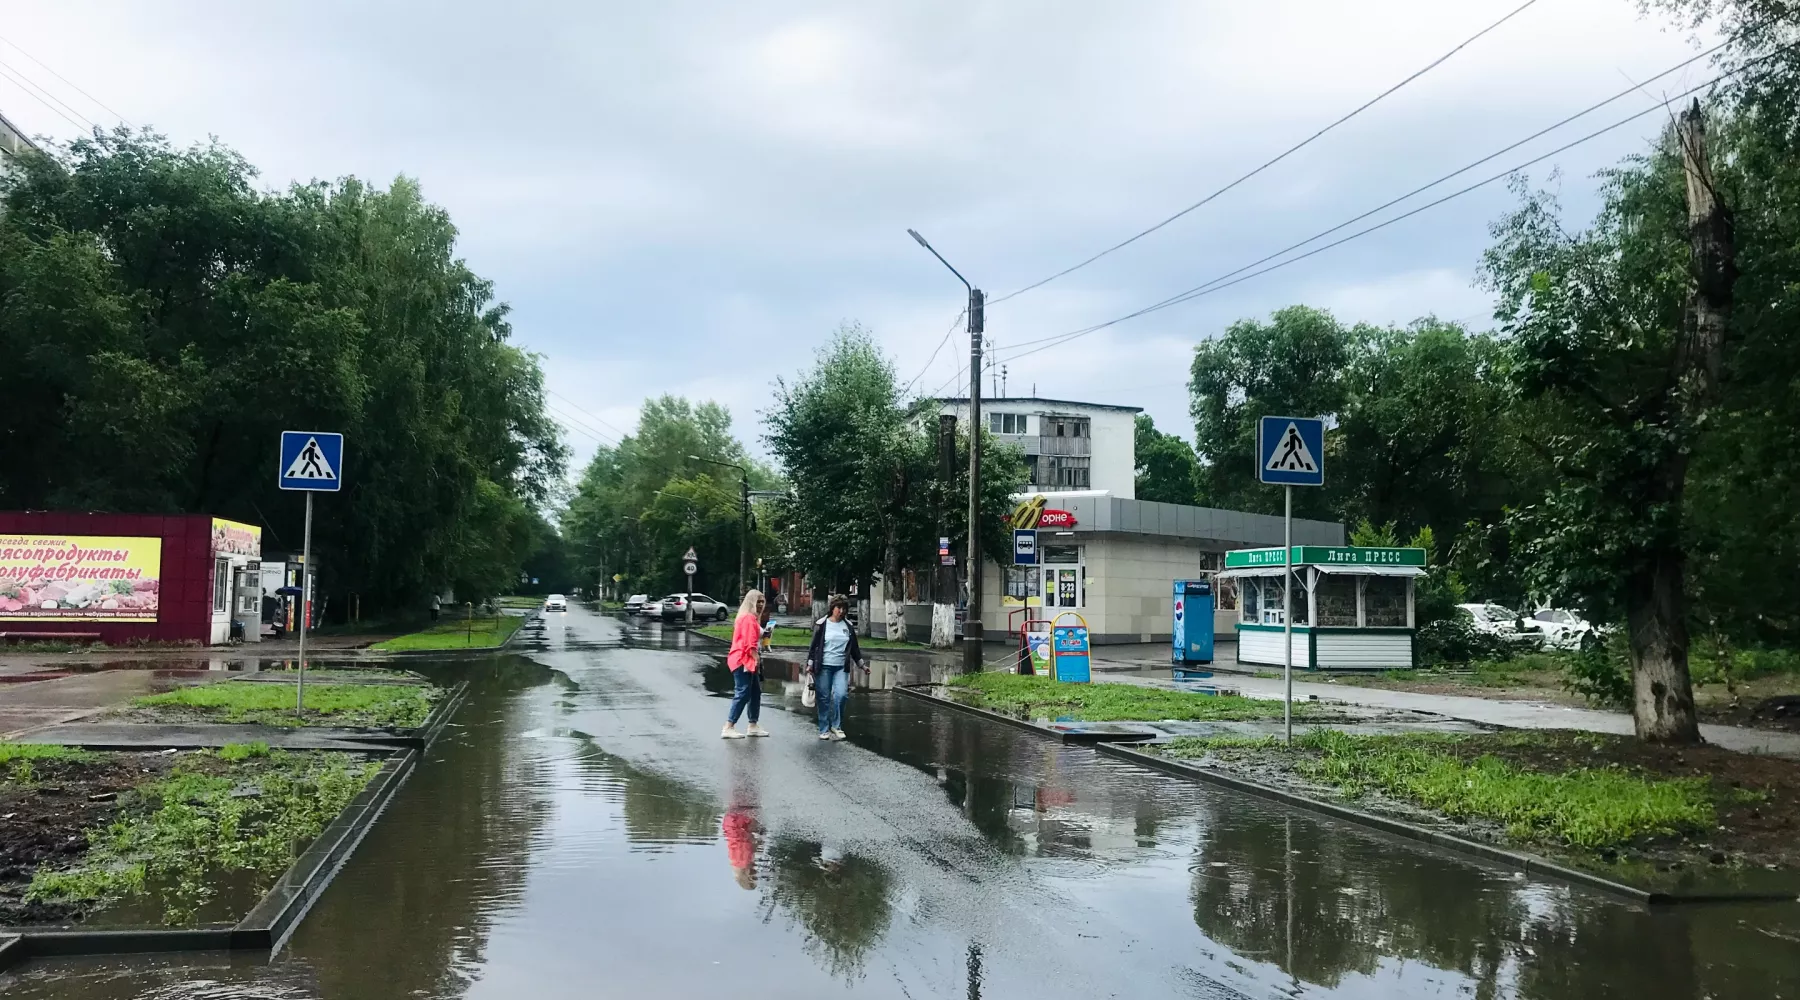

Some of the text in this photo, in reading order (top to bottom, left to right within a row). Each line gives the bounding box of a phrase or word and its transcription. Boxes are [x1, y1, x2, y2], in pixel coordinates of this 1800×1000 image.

[0, 544, 129, 565] ясопродукты
[1265, 551, 1283, 562] ПРЕСС
[1327, 550, 1400, 562] Лига ПРЕСС
